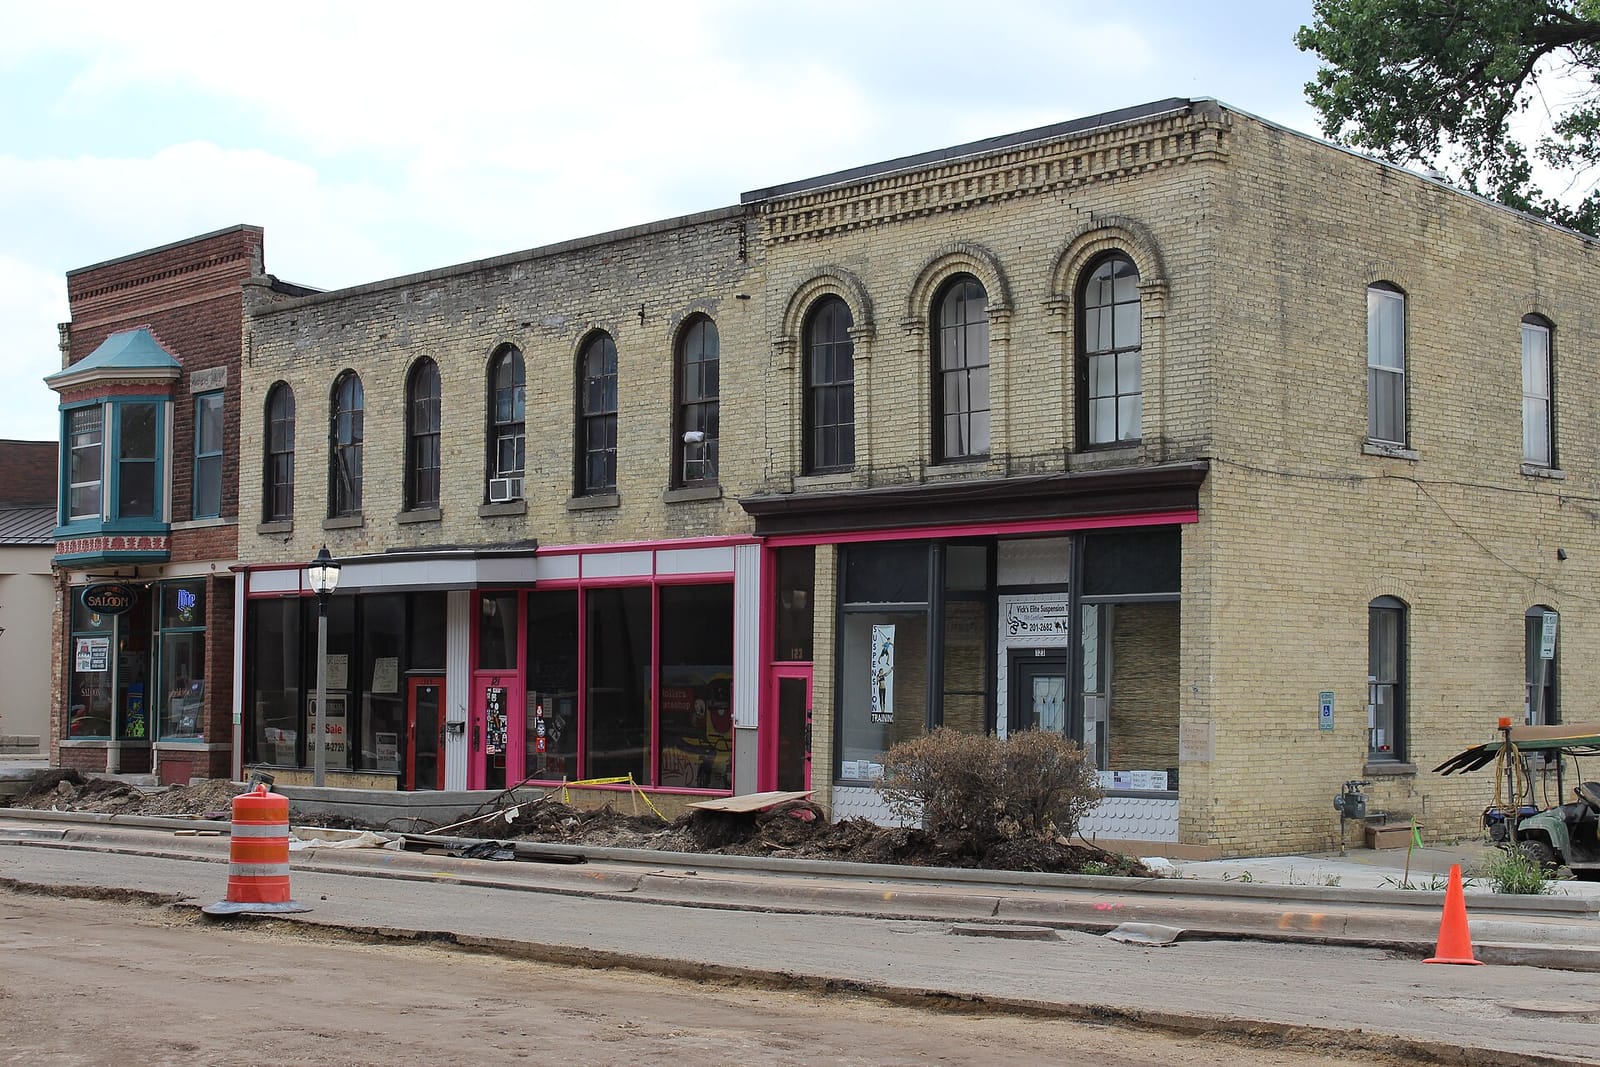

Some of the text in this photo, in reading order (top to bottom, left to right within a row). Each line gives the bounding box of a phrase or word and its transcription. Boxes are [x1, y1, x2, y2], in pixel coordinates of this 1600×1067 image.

[88, 596, 129, 607] SALOON
[1040, 604, 1065, 614] Suspension
[1029, 622, 1053, 632] 201-2682
[325, 723, 343, 735] Sale
